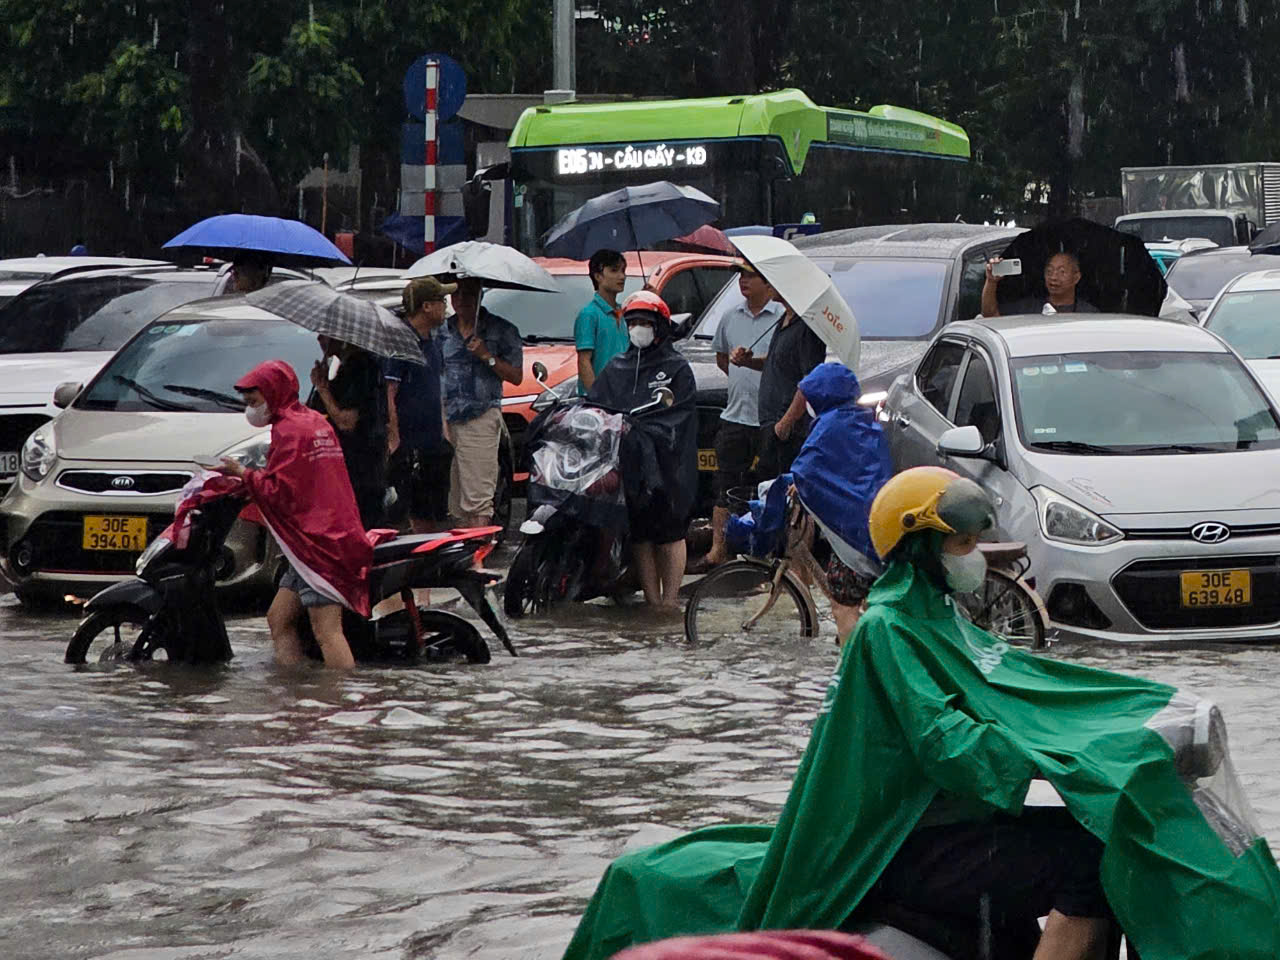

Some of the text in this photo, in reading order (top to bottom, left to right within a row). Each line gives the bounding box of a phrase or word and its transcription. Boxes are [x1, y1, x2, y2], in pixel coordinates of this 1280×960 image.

[102, 518, 129, 533] 30E
[90, 534, 140, 549] 394.01
[1200, 572, 1232, 588] 30E
[1189, 588, 1244, 605] 639.48
